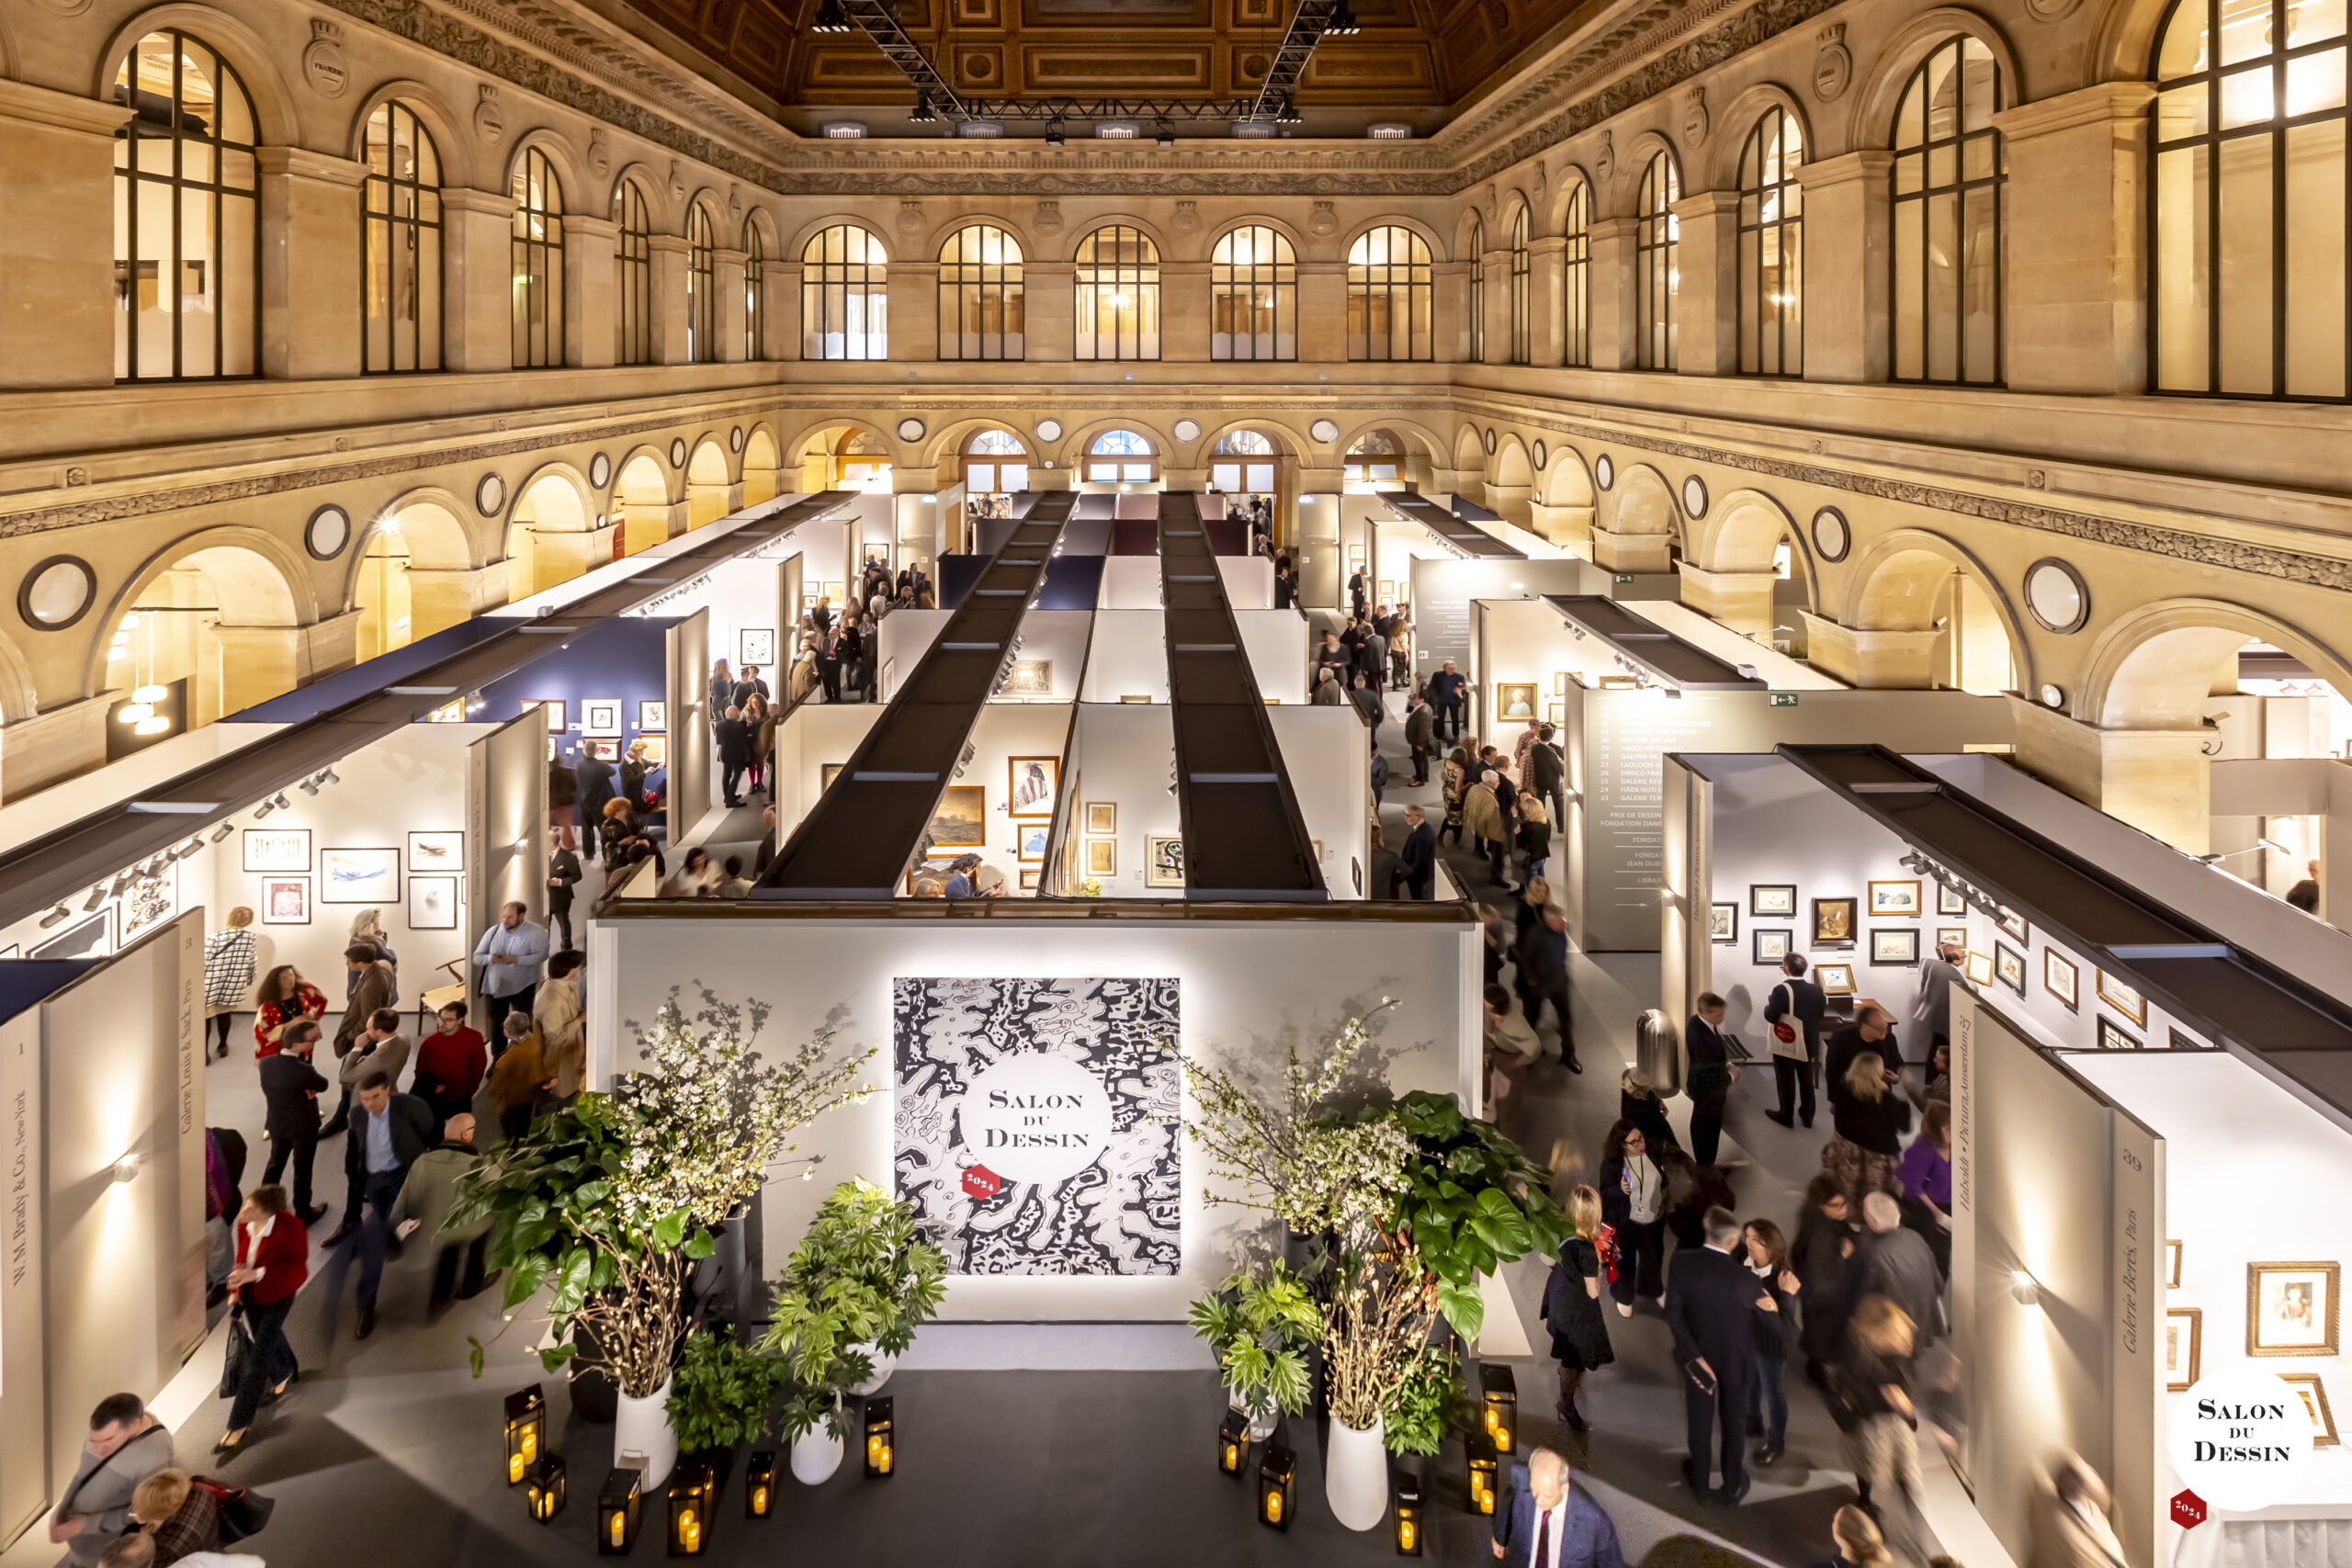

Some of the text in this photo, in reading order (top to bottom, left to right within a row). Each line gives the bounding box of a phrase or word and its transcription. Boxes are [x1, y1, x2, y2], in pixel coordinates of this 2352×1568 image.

[183, 977, 192, 1005] Paris
[181, 1039, 192, 1052] &
[181, 1052, 192, 1089] Louis
[180, 1089, 192, 1135] Galerie
[989, 1089, 1083, 1109] SALON
[1023, 1116, 1050, 1126] DU
[985, 1129, 1089, 1147] DESSIN
[12, 1177, 26, 1193] &
[967, 1173, 994, 1191] 2024
[1959, 1156, 1970, 1213] Haboldt
[12, 1193, 29, 1241] Brady
[2124, 1207, 2137, 1241] Paris
[13, 1237, 26, 1263] M.
[13, 1260, 26, 1287] W.
[2122, 1293, 2137, 1354] Galerie
